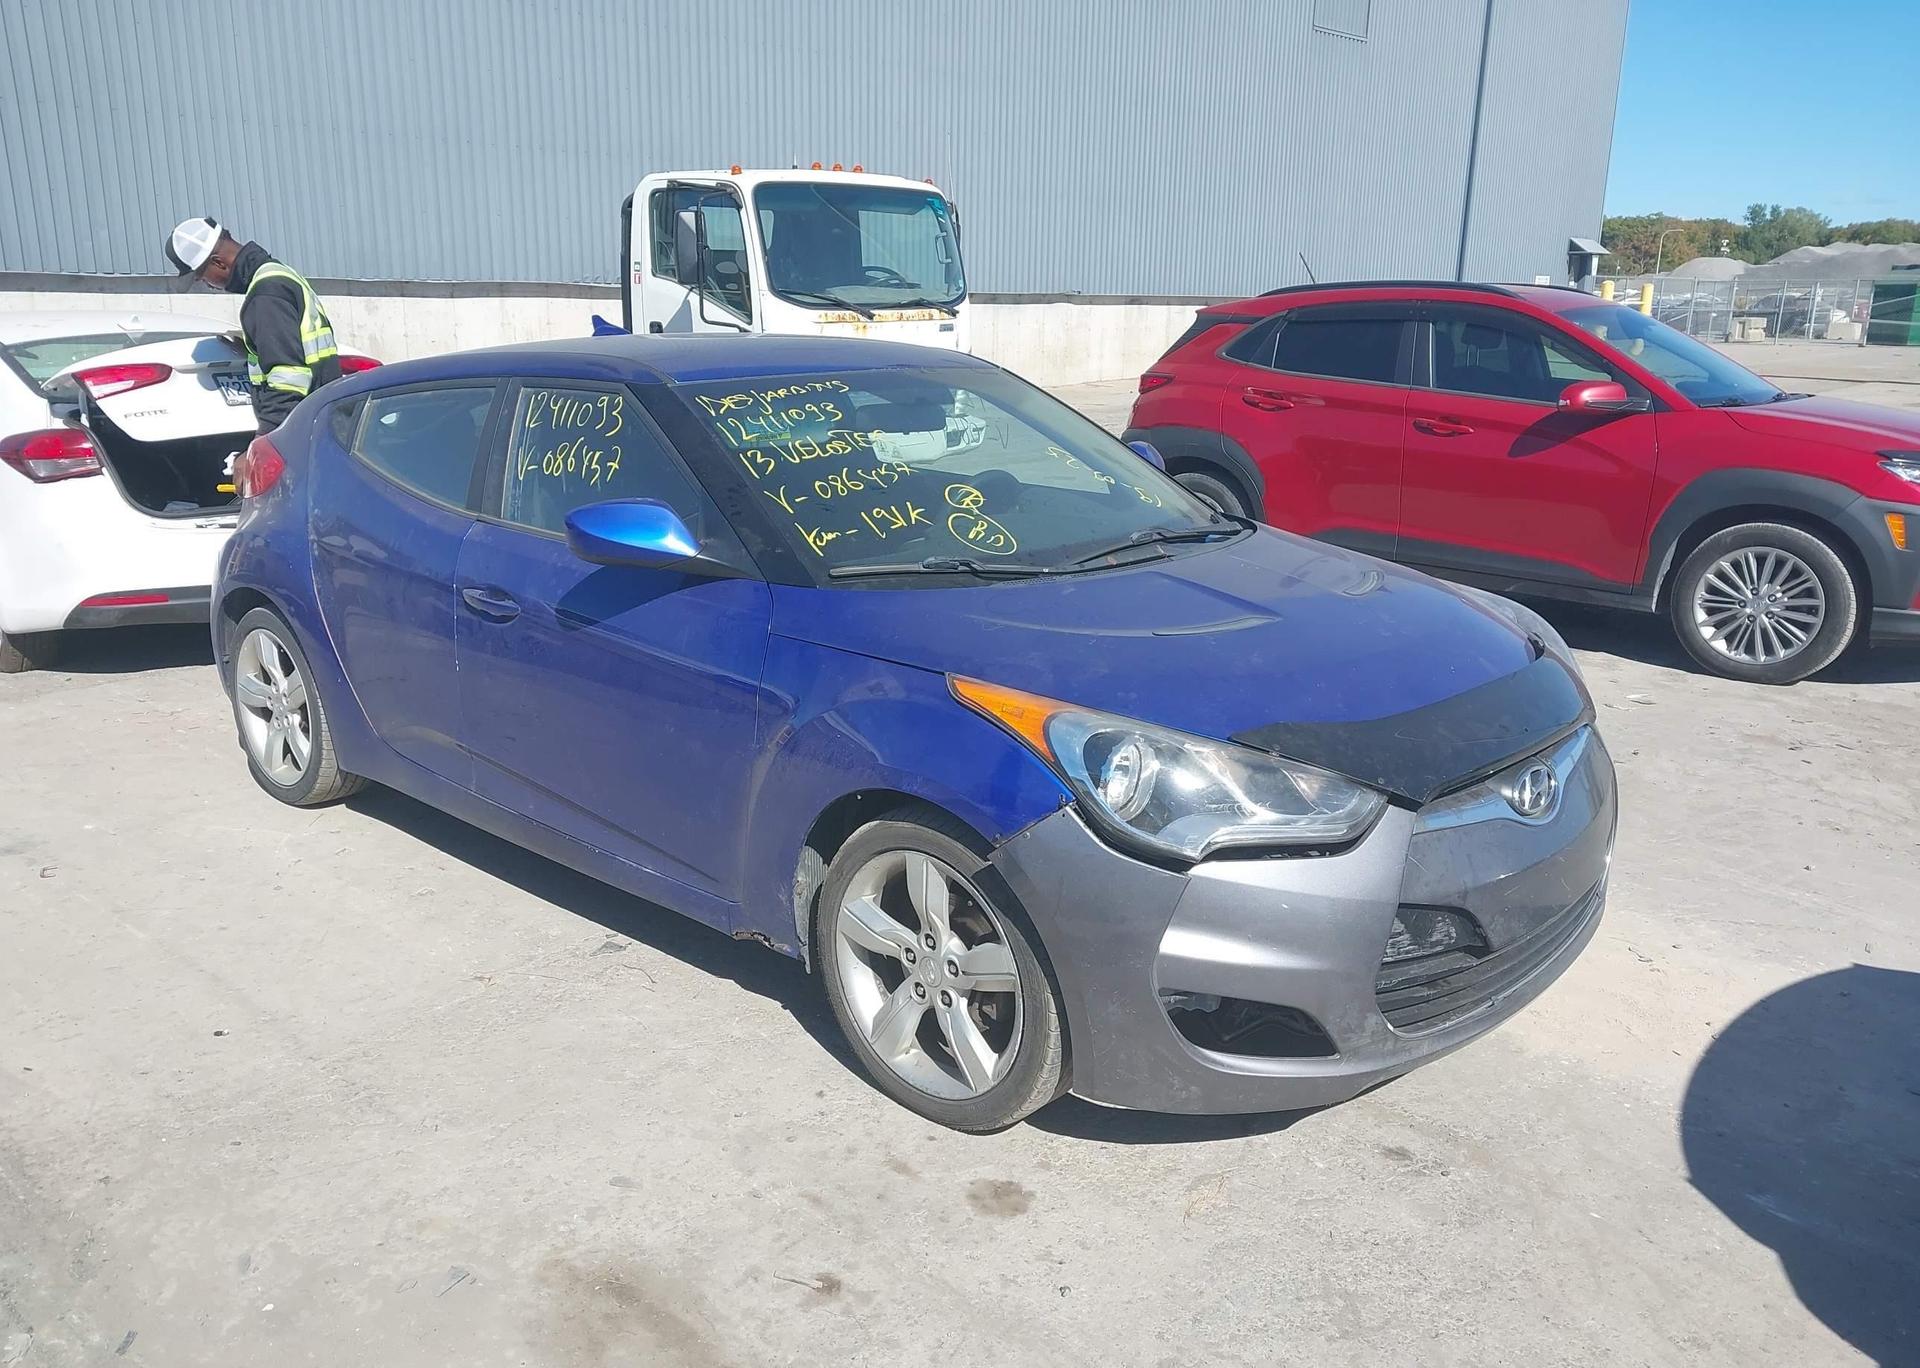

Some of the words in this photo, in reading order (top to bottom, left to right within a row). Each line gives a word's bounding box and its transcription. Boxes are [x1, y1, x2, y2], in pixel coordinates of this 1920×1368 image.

[525, 391, 624, 437] 12411093
[716, 401, 843, 447] 12411093
[739, 449, 776, 479] 13
